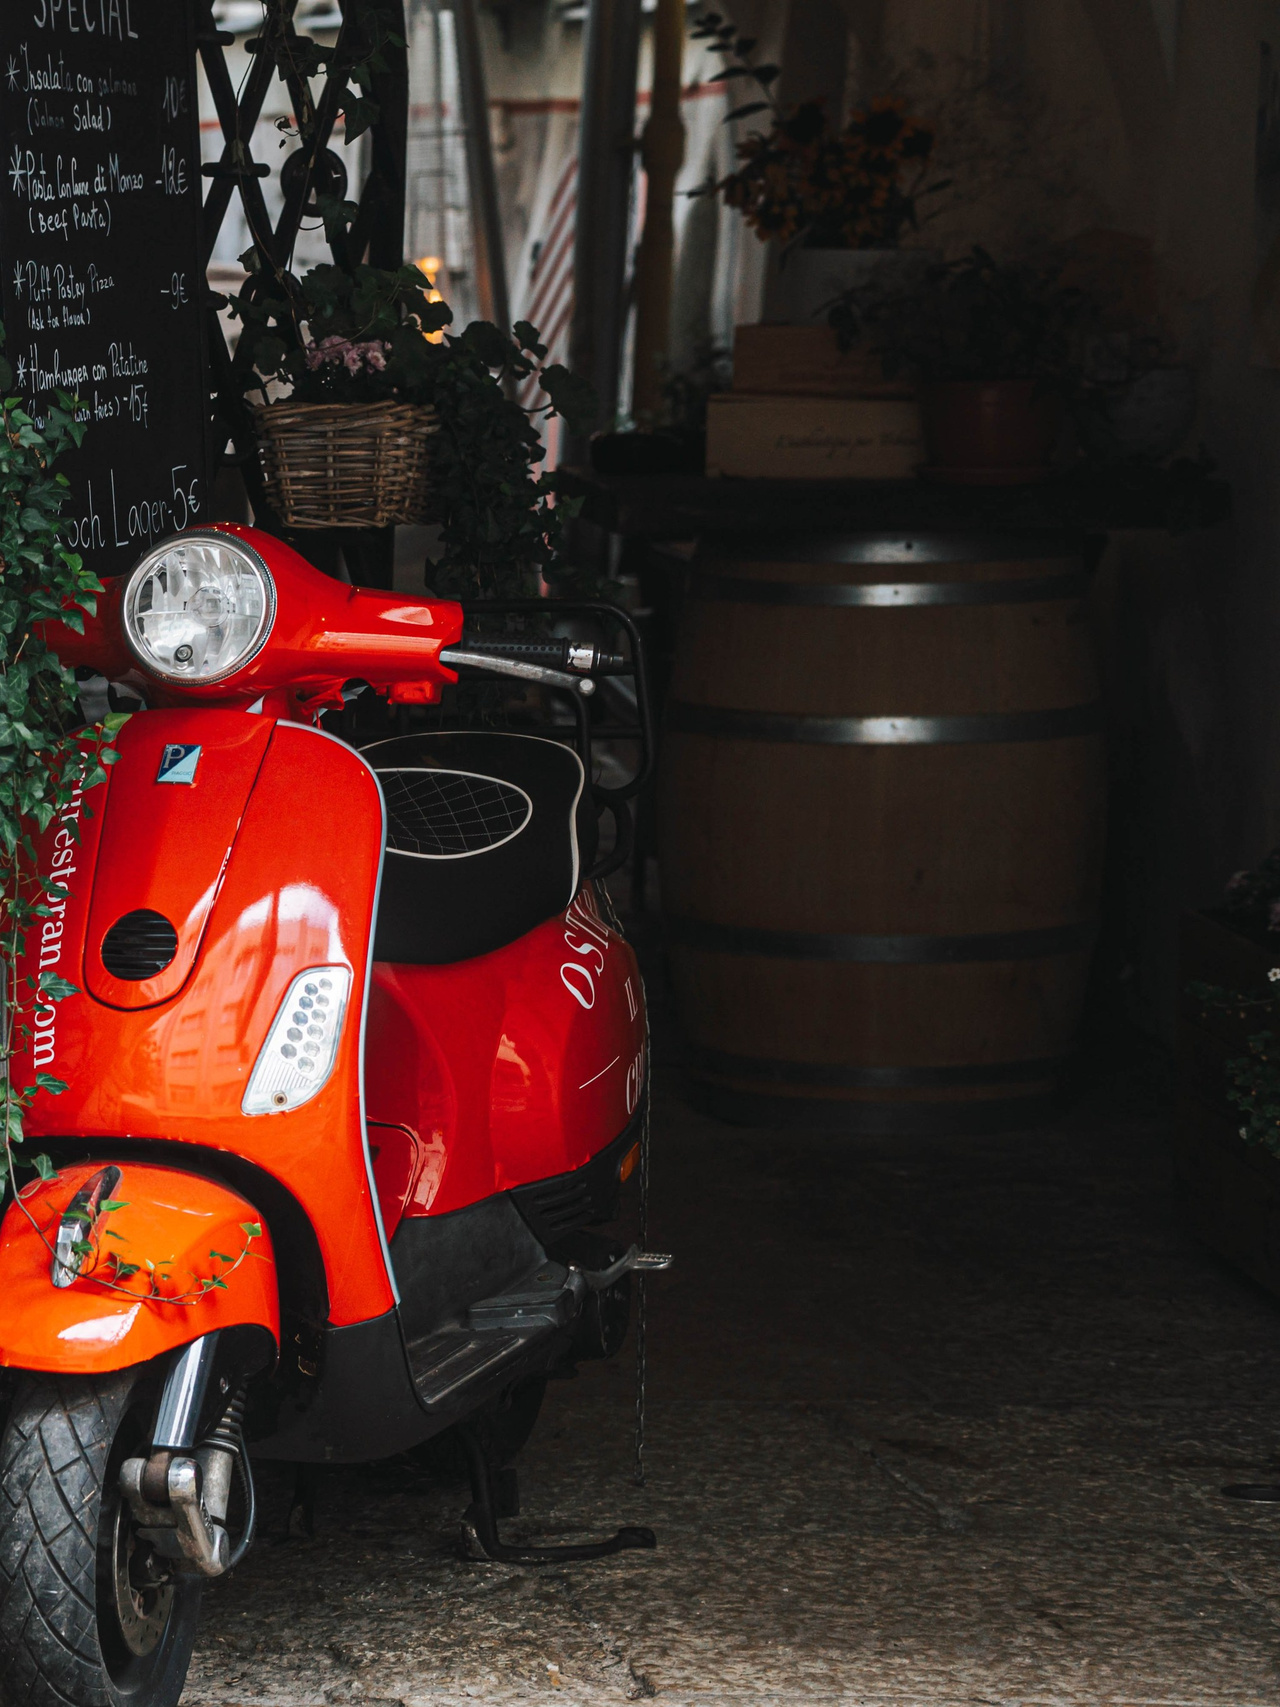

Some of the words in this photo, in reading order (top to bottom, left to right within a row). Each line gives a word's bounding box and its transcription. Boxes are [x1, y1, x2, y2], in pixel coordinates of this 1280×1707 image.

[76, 73, 94, 94] con
[94, 164, 107, 194] di
[25, 260, 52, 301] Puff
[92, 364, 108, 381] con
[52, 480, 106, 550] och
